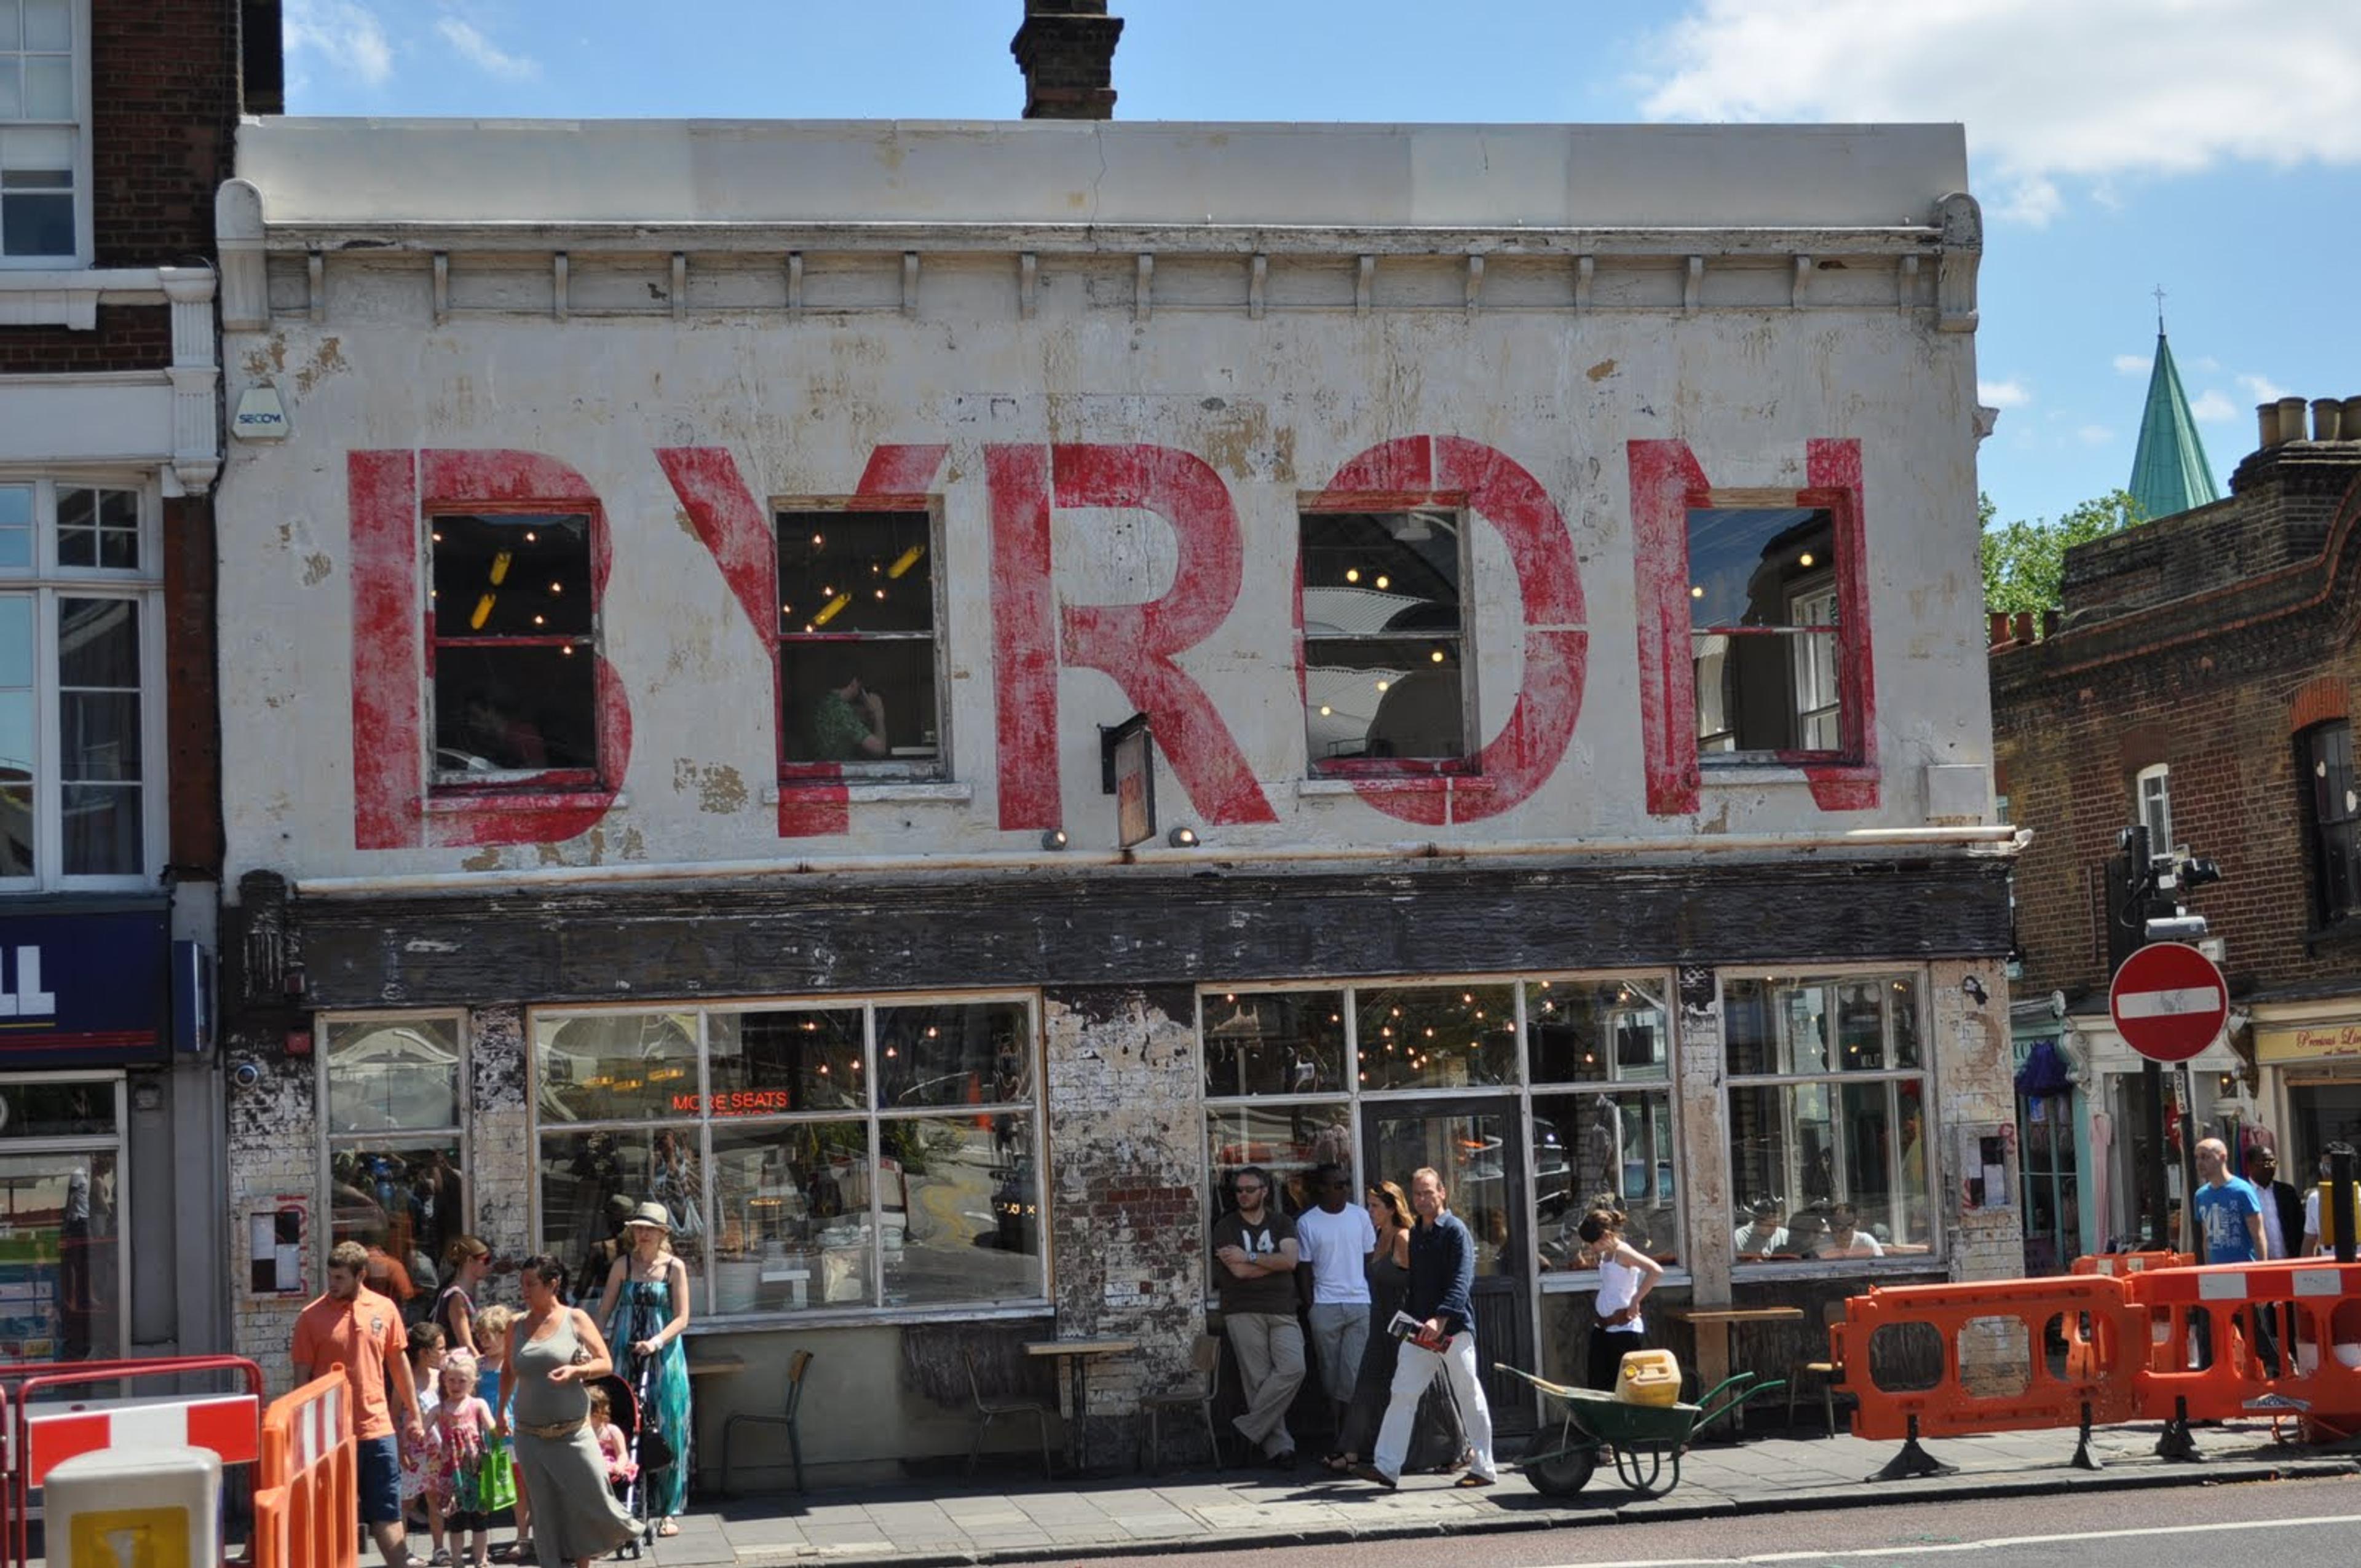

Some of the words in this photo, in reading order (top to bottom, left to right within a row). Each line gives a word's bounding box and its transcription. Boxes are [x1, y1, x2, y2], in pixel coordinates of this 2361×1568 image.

[239, 412, 282, 424] SECOM
[346, 433, 1881, 851] BYRON
[731, 1091, 789, 1108] SEATS
